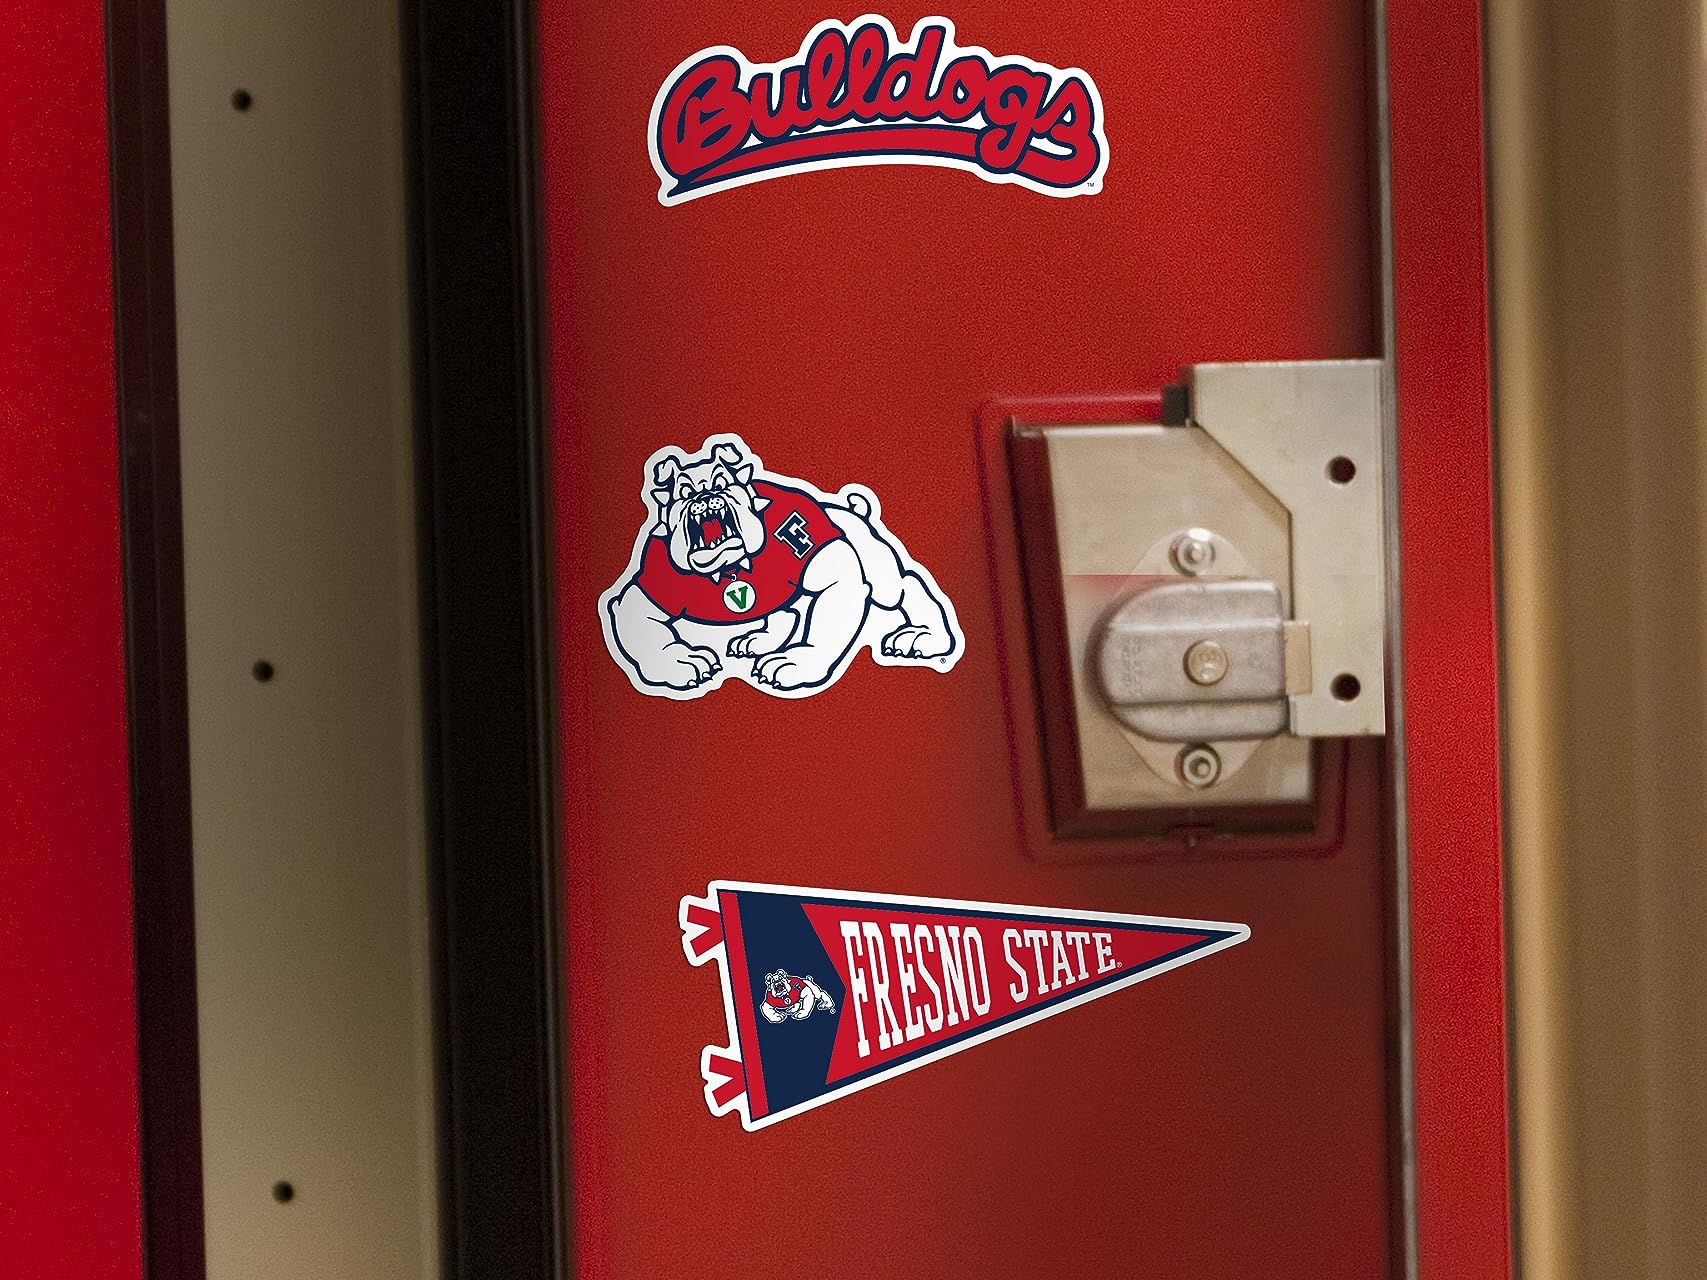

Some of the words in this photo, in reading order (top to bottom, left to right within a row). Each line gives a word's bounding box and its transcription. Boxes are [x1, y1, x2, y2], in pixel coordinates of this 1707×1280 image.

[657, 23, 1100, 192] Bulldogs
[774, 510, 814, 559] F
[726, 586, 749, 610] V
[840, 920, 992, 1058] FRESNO
[1003, 928, 1117, 1003] STATE
